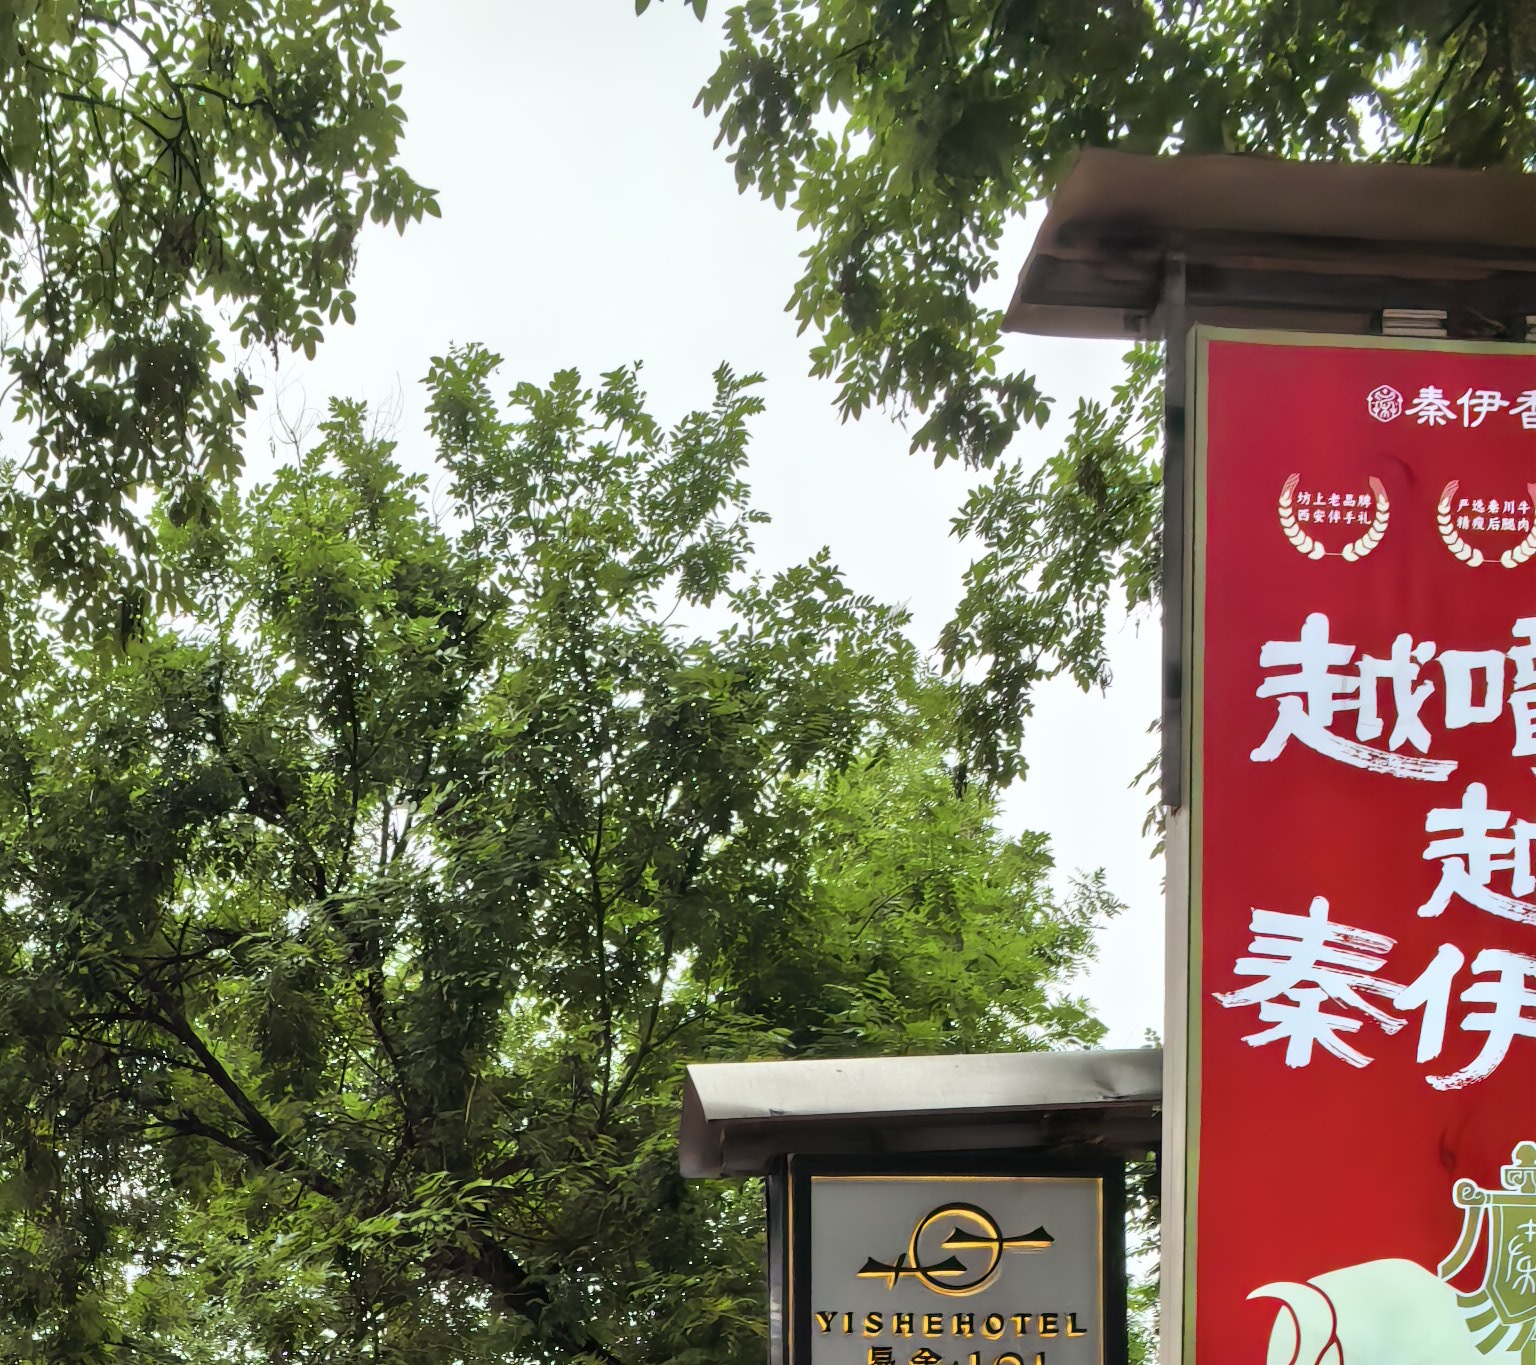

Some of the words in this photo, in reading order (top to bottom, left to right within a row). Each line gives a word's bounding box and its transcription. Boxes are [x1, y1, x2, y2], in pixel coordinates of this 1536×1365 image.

[1297, 491, 1372, 508] 坊上老品牌
[1457, 499, 1531, 515] 严选秦川牛
[1297, 508, 1372, 525] 西安伴手礼
[1456, 516, 1530, 533] 精瘦后腿肉
[815, 1310, 1088, 1339] YISHEHOTEL
